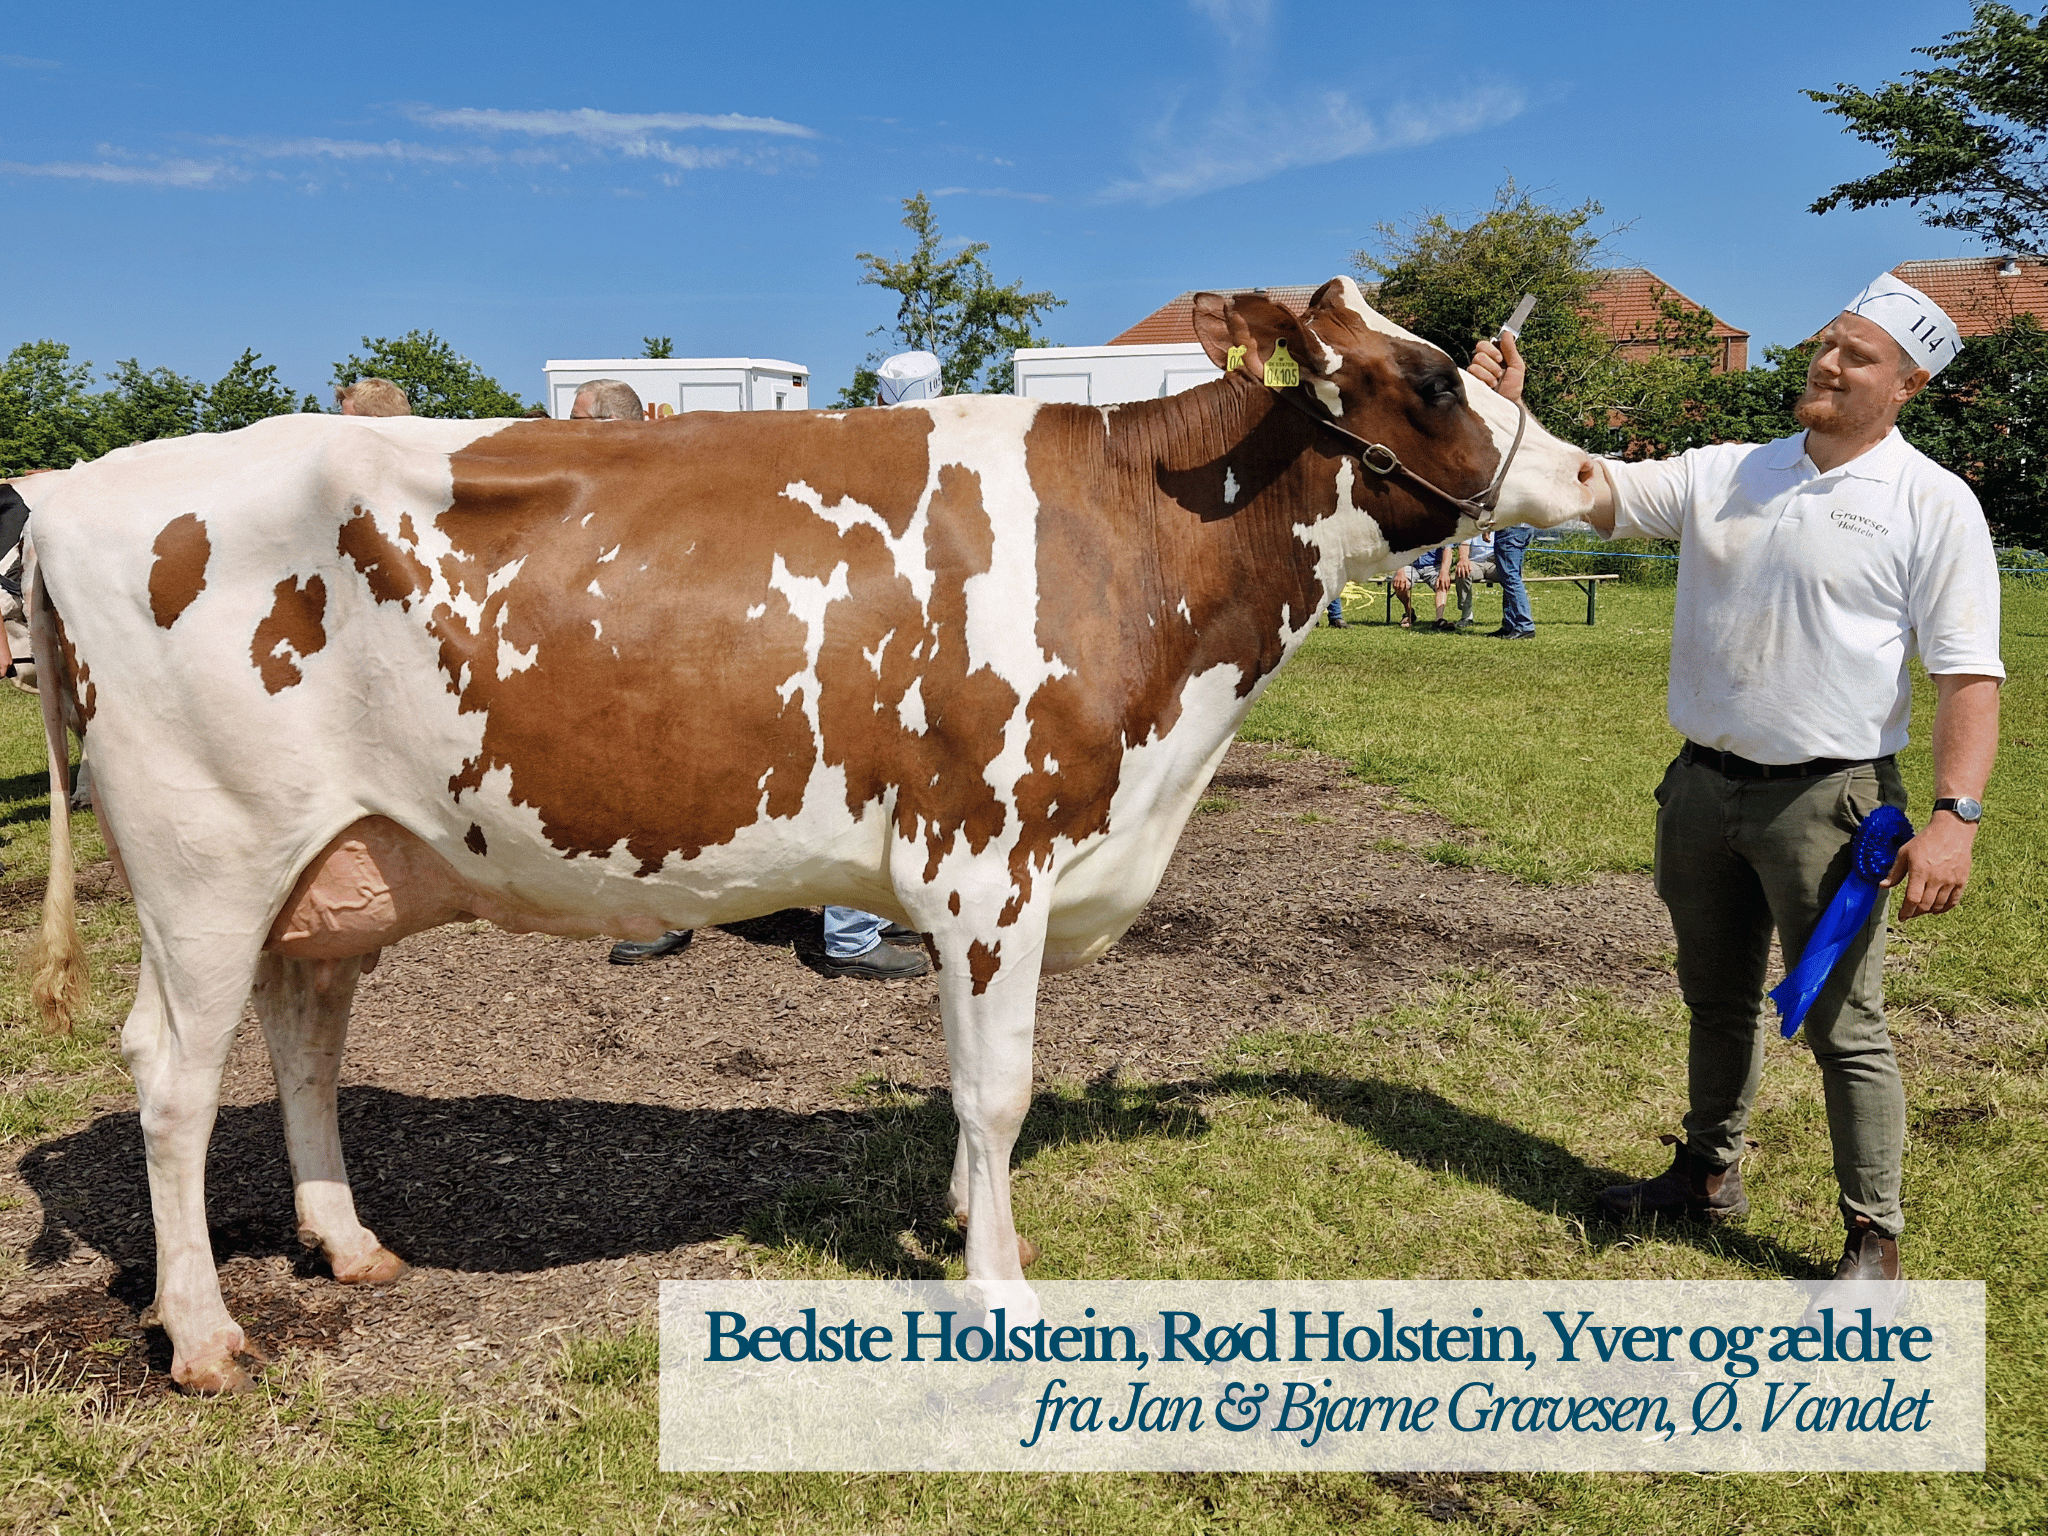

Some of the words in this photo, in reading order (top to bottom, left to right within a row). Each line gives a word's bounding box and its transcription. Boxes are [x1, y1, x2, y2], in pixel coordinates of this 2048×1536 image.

[1908, 315, 1946, 354] 114
[1266, 368, 1297, 385] 04105
[1830, 508, 1889, 536] Gravesen
[1837, 520, 1874, 538] Holstein
